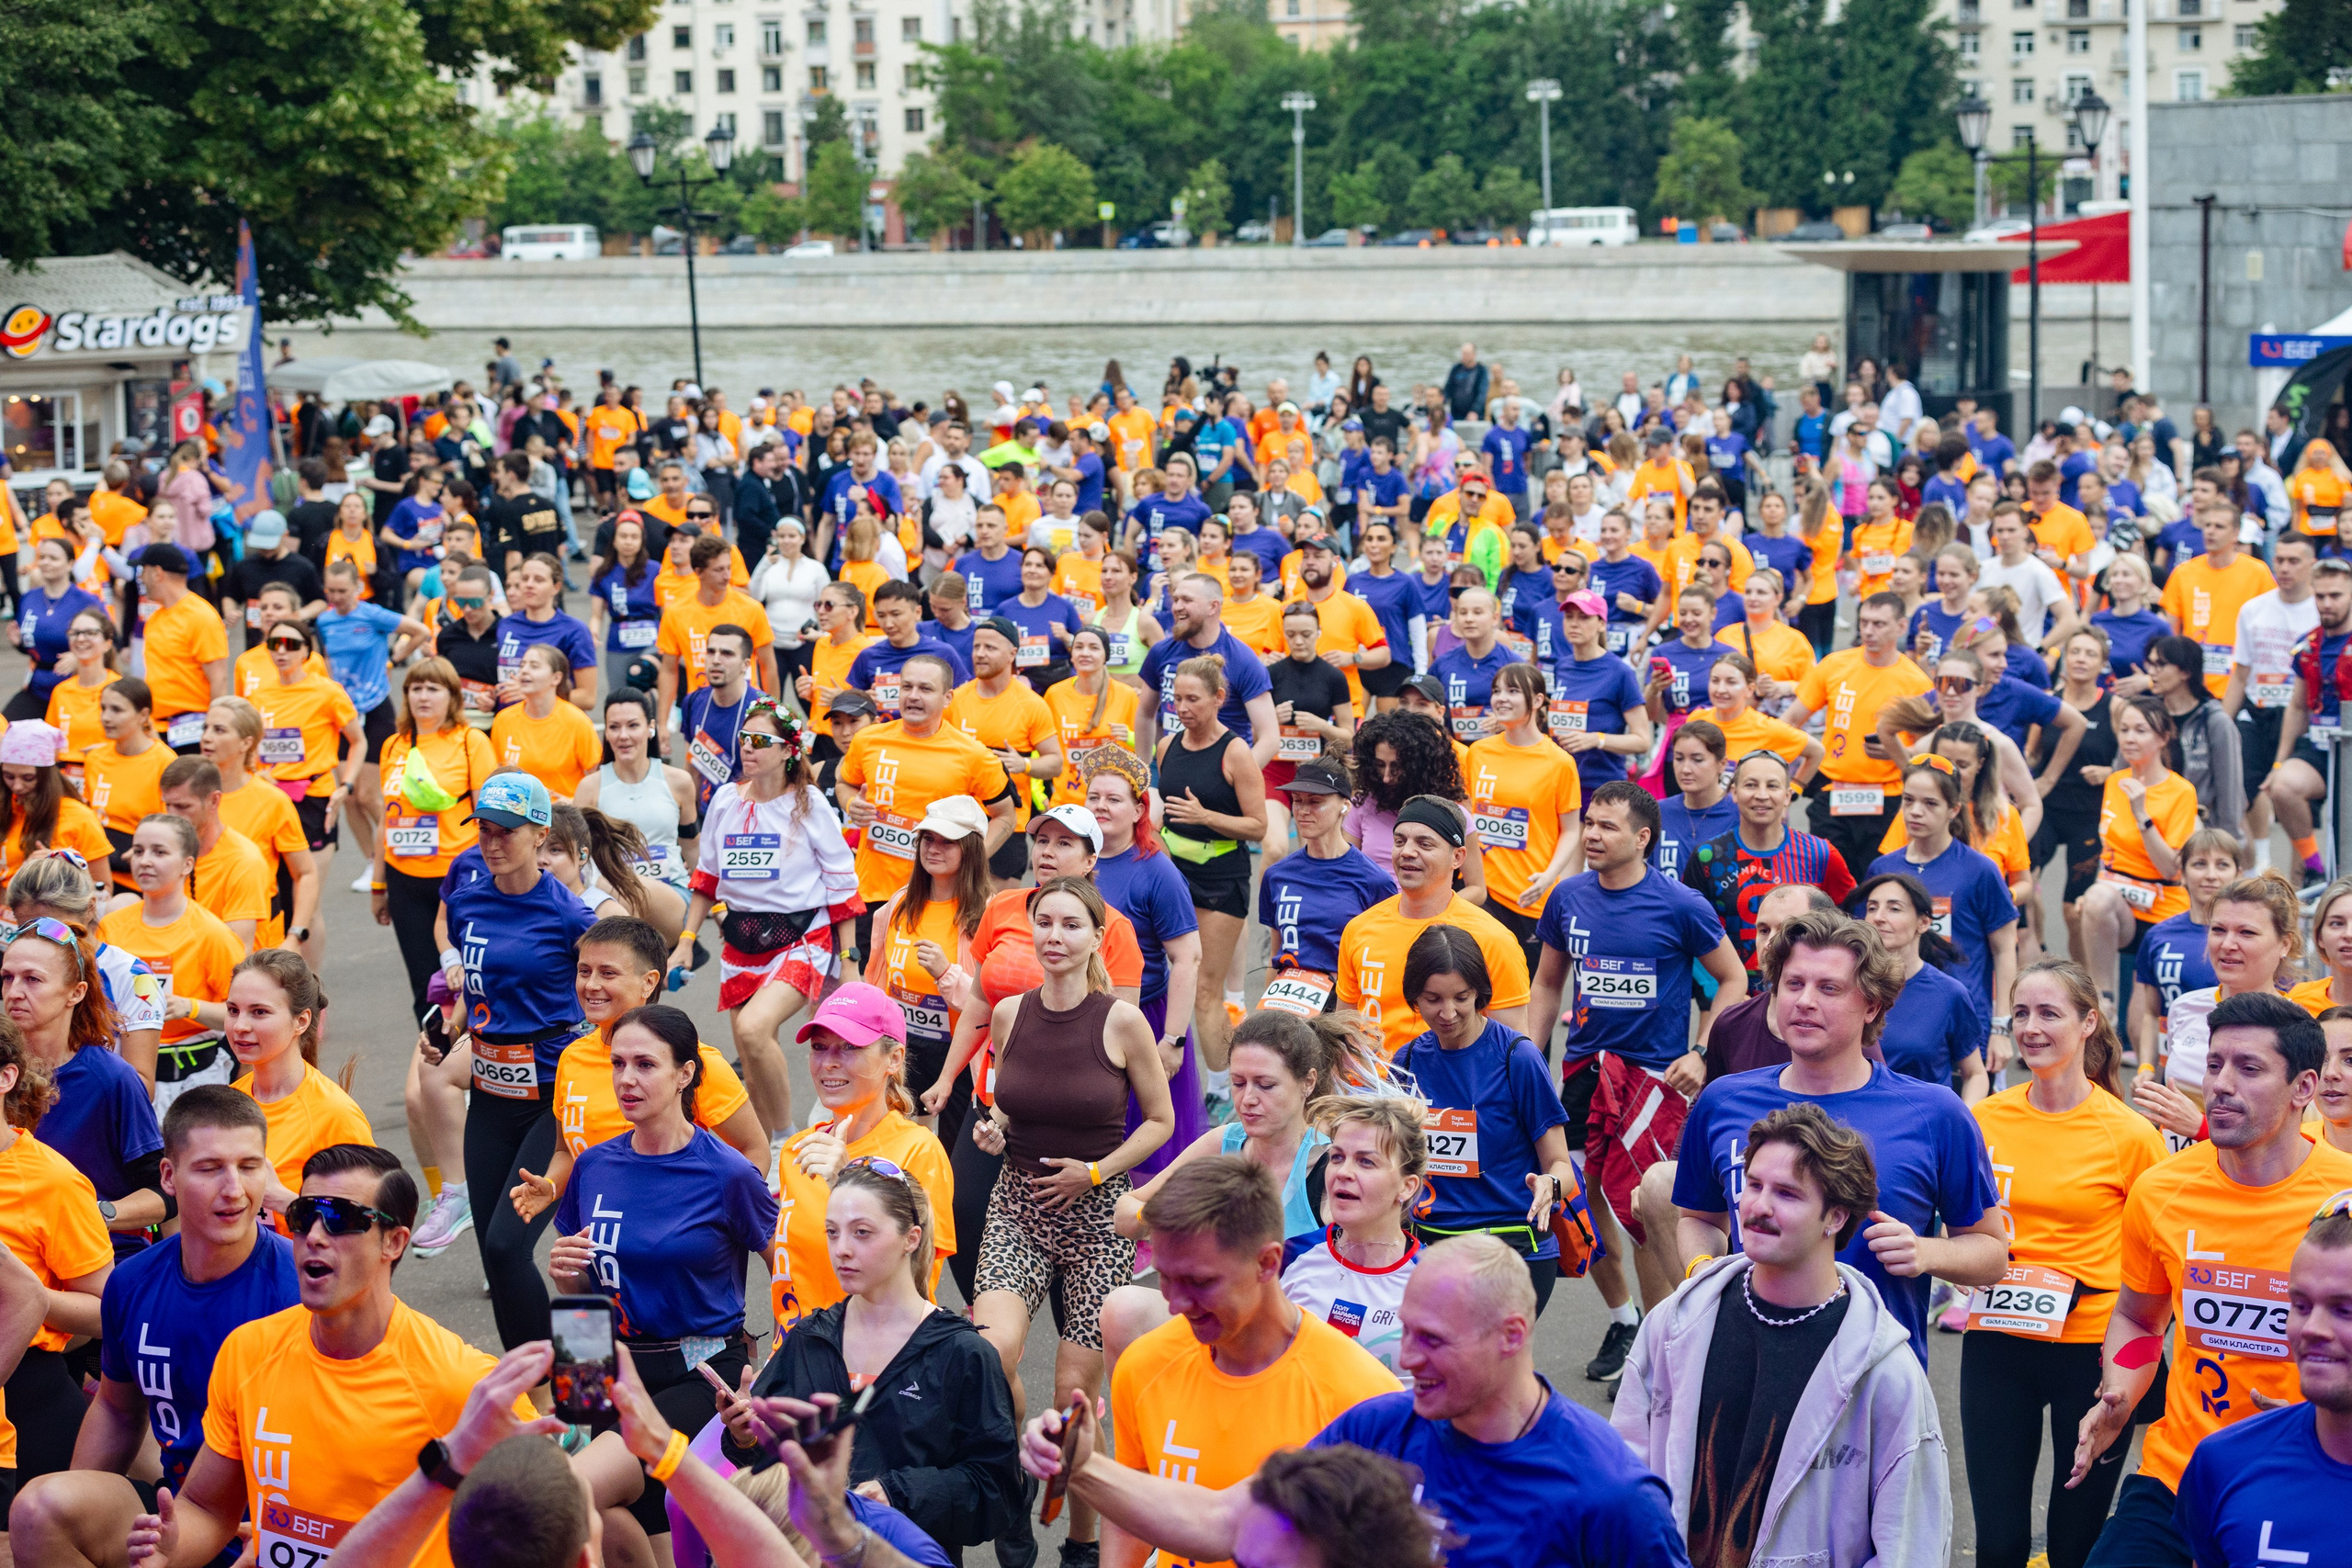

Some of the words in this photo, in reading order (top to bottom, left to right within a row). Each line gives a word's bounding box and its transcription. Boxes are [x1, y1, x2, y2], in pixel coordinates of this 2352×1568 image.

[56, 309, 240, 354] Stardogs
[968, 572, 983, 608] БЕГ
[499, 631, 520, 658] ЕГ
[688, 627, 706, 669] БЕГ
[1017, 647, 1044, 658] 493
[883, 688, 899, 699] 12
[1671, 665, 1690, 707] БЕГ
[1833, 681, 1857, 730] БЕГ
[1170, 716, 1182, 729] 17
[1456, 720, 1477, 731] 00
[1551, 715, 1583, 728] 0575
[504, 735, 522, 766] ЕГ
[1279, 739, 1317, 750] 0639
[693, 743, 728, 779] 0068
[875, 749, 899, 807] БЕГ
[1475, 764, 1498, 801] ЕГ
[486, 787, 509, 796] NICE
[1838, 793, 1876, 804] 1599
[1487, 805, 1507, 816] БЕГ
[887, 814, 908, 827] БЕГ
[1476, 818, 1525, 837] 0063
[392, 831, 432, 843] 0172
[736, 836, 755, 846] БЕГ
[871, 825, 917, 848] 050
[727, 852, 775, 865] 2557
[636, 863, 662, 876] 23
[1720, 865, 1770, 889] OLYMPIC
[2119, 887, 2147, 903] 461
[1277, 886, 1302, 951] БЕГ
[462, 921, 490, 998] БЕГ
[1600, 959, 1625, 971] БЕГ
[1284, 967, 1306, 978] БЕГ
[1360, 947, 1385, 1023] БЕГ
[1587, 976, 1650, 995] 2546
[842, 997, 857, 1005] Klein
[901, 990, 921, 1004] БЕГ
[1267, 983, 1321, 1007] 0444
[480, 1044, 500, 1058] БЕГ
[474, 1059, 532, 1083] 0662
[1427, 1134, 1467, 1156] 427
[1430, 1163, 1456, 1172] КЛАСТЕР
[588, 1194, 623, 1289] БЕГ
[2042, 1277, 2070, 1289] Горького
[2043, 1272, 2061, 1280] Парк
[2215, 1269, 2256, 1290] БЕГ
[1333, 1303, 1350, 1313] ПОЛУ
[1984, 1289, 2057, 1314] 1236
[1331, 1309, 1361, 1320] МАРАФОН
[1372, 1310, 1395, 1325] GRi
[2194, 1298, 2290, 1335] 0773
[1984, 1318, 2005, 1326] 5КМ
[2006, 1319, 2035, 1329] КЛАСТЕР
[2209, 1337, 2228, 1348] 5КМ
[2230, 1339, 2272, 1353] КЛАСТЕР
[138, 1323, 180, 1440] БЕГ
[899, 1390, 922, 1401] DEMIX
[292, 1515, 334, 1540] БЕГ
[269, 1540, 329, 1568] 07
